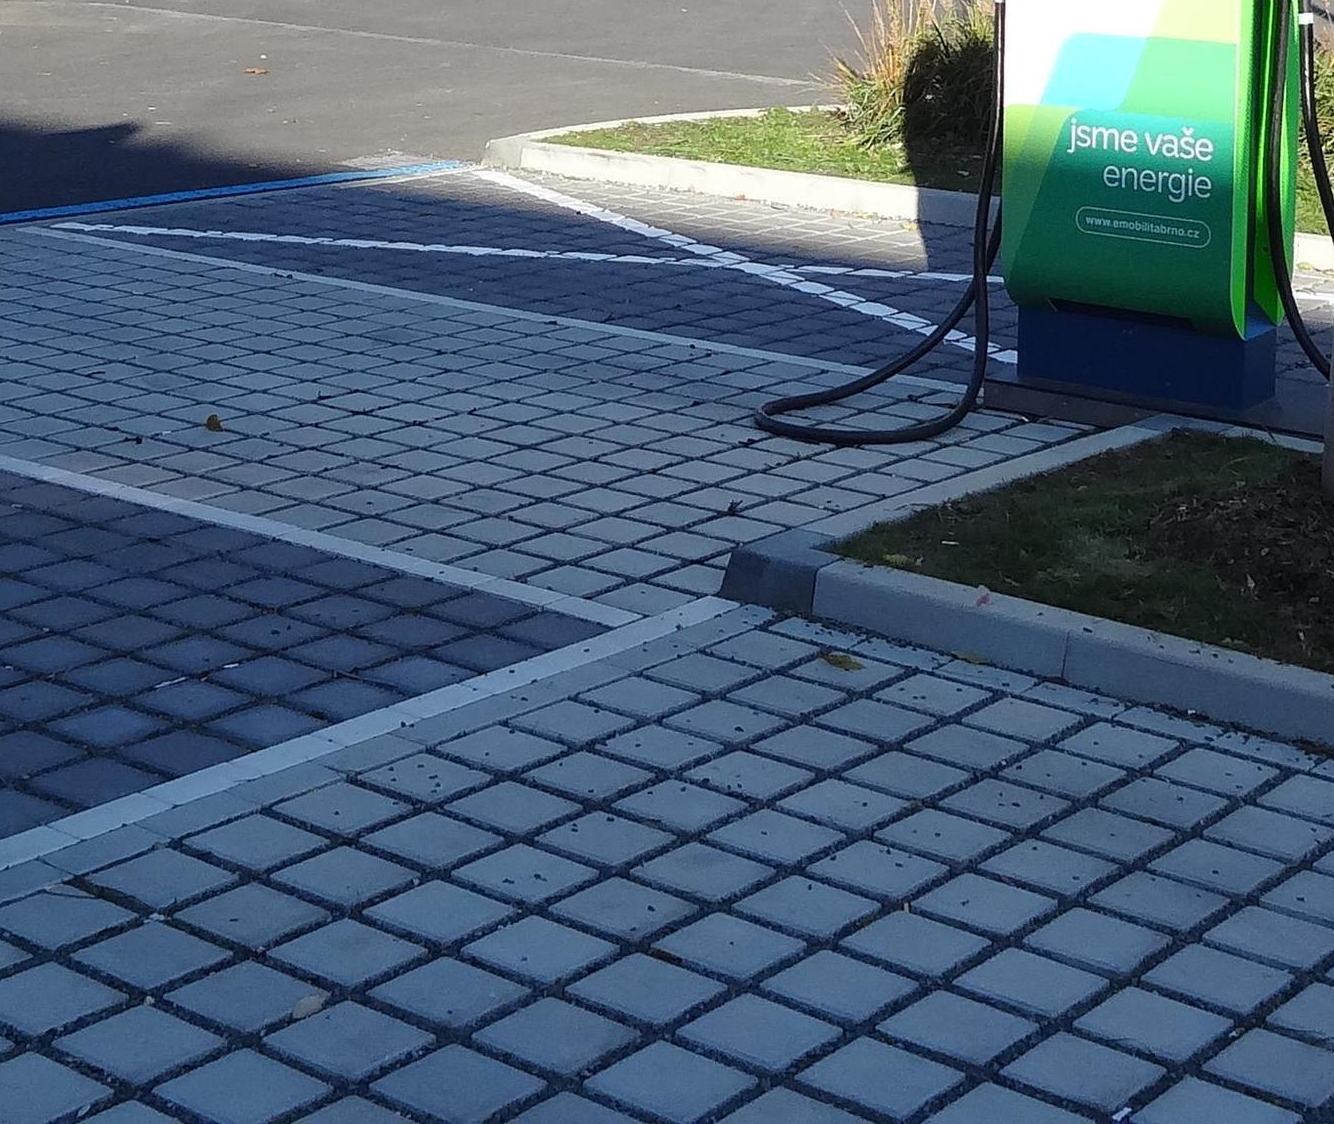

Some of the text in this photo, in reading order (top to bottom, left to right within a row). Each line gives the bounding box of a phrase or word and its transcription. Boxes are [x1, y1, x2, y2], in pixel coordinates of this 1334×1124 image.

[1067, 117, 1214, 161] jsme vaše
[1103, 165, 1212, 203] energie
[1085, 215, 1200, 239] www.emobilitabrno.cz
